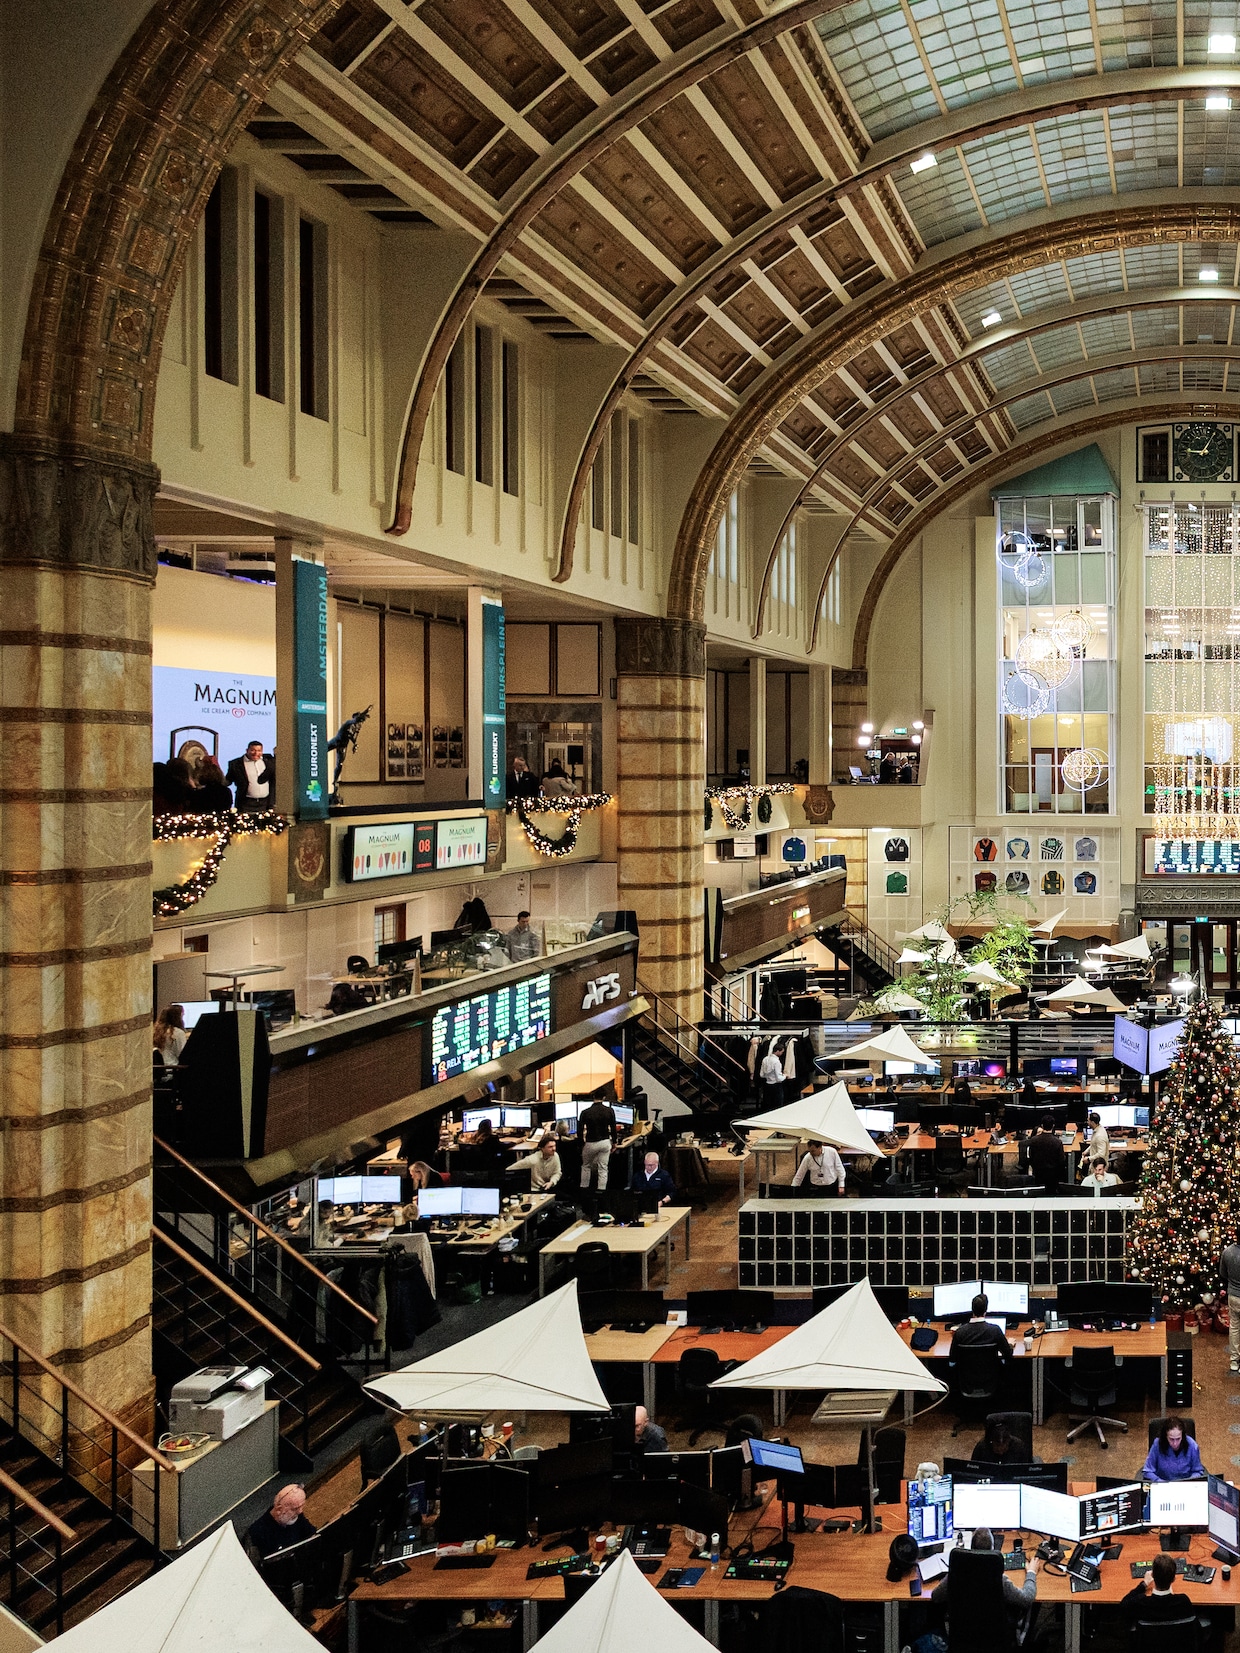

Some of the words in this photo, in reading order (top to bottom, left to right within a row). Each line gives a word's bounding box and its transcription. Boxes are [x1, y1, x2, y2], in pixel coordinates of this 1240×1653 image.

[319, 576, 327, 680] AMSTERDAM
[498, 626, 506, 710] BEURSPLEIN
[194, 683, 276, 707] MAGNUM
[310, 723, 318, 777] EURONEXT
[368, 833, 400, 845] MAGNUM
[449, 826, 476, 836] MAGNUM
[418, 838, 431, 853] 08
[582, 972, 621, 1010] AFS
[1120, 1035, 1140, 1051] MAGNUM
[446, 1056, 461, 1070] RELX
